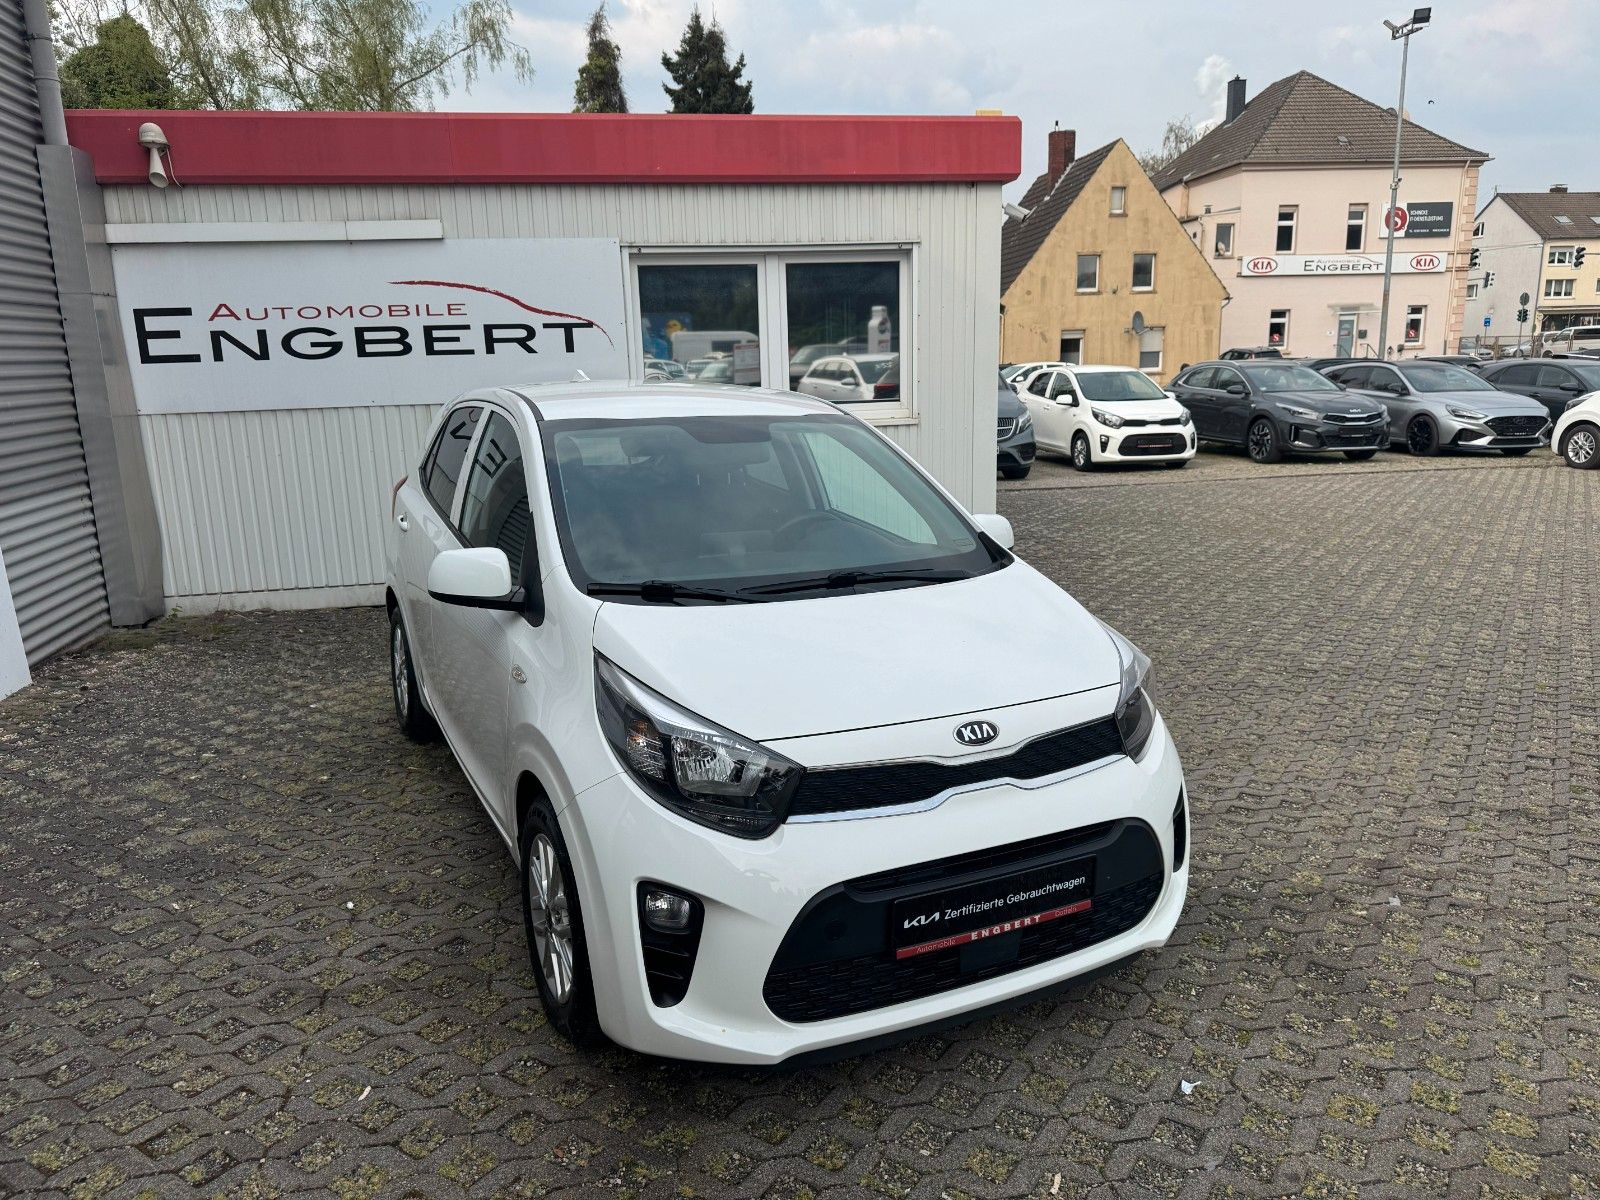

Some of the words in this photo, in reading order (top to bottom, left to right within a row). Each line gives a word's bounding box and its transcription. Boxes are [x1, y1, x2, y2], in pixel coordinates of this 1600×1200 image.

[1253, 261, 1272, 270] KIA
[1304, 260, 1384, 272] ENGBERT
[1415, 258, 1435, 267] KIA
[208, 303, 467, 322] AUTOMOBILE
[133, 307, 594, 364] ENGBERT
[960, 723, 994, 741] KIA
[904, 911, 940, 929] KIA
[944, 898, 1004, 920] Zertifizierte
[1006, 876, 1086, 904] Gebrauchtwagen
[917, 938, 956, 954] Automobile
[971, 915, 1041, 941] ENGBERT
